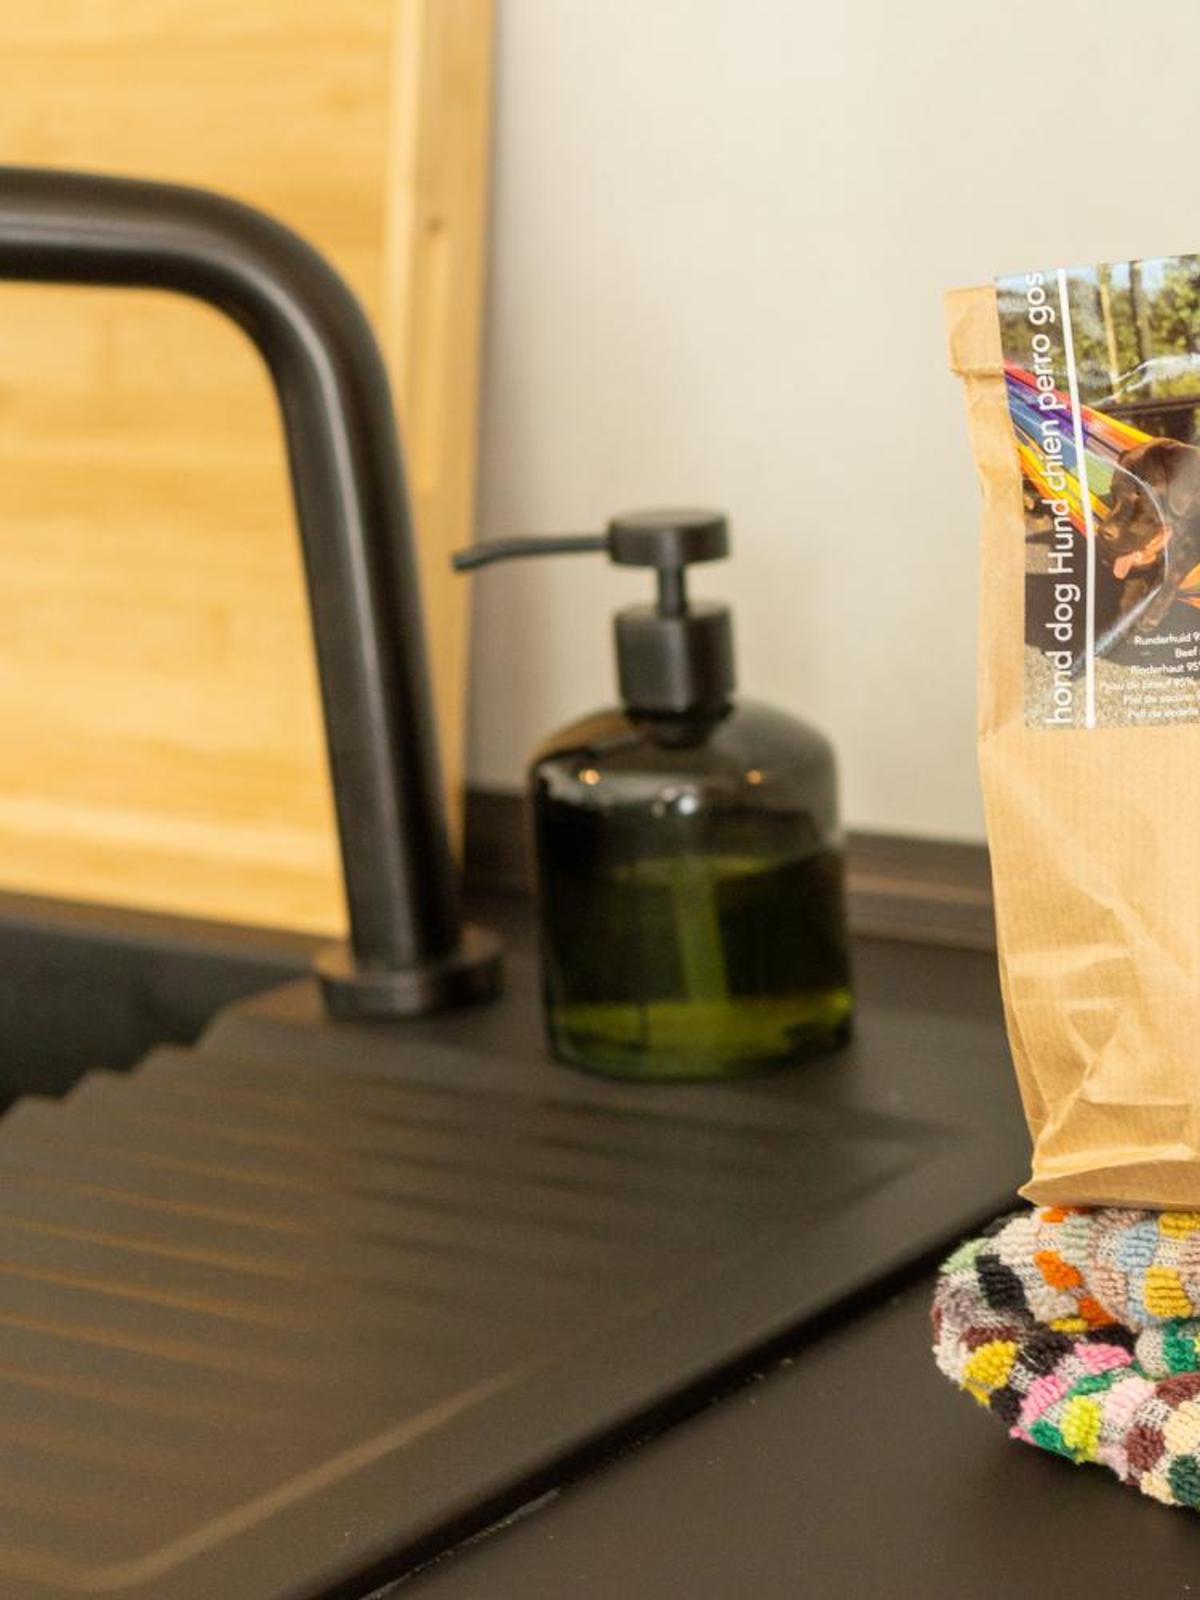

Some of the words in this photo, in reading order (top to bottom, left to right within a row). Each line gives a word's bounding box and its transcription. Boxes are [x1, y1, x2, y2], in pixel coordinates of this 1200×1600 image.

[1025, 271, 1055, 326] gos
[1032, 333, 1067, 411] perro
[1039, 419, 1066, 492] chien
[1041, 498, 1075, 574] Hund
[1045, 582, 1081, 641] dog
[1134, 632, 1191, 646] Runderhuid
[1175, 646, 1197, 658] Beef
[1045, 650, 1073, 724] hond
